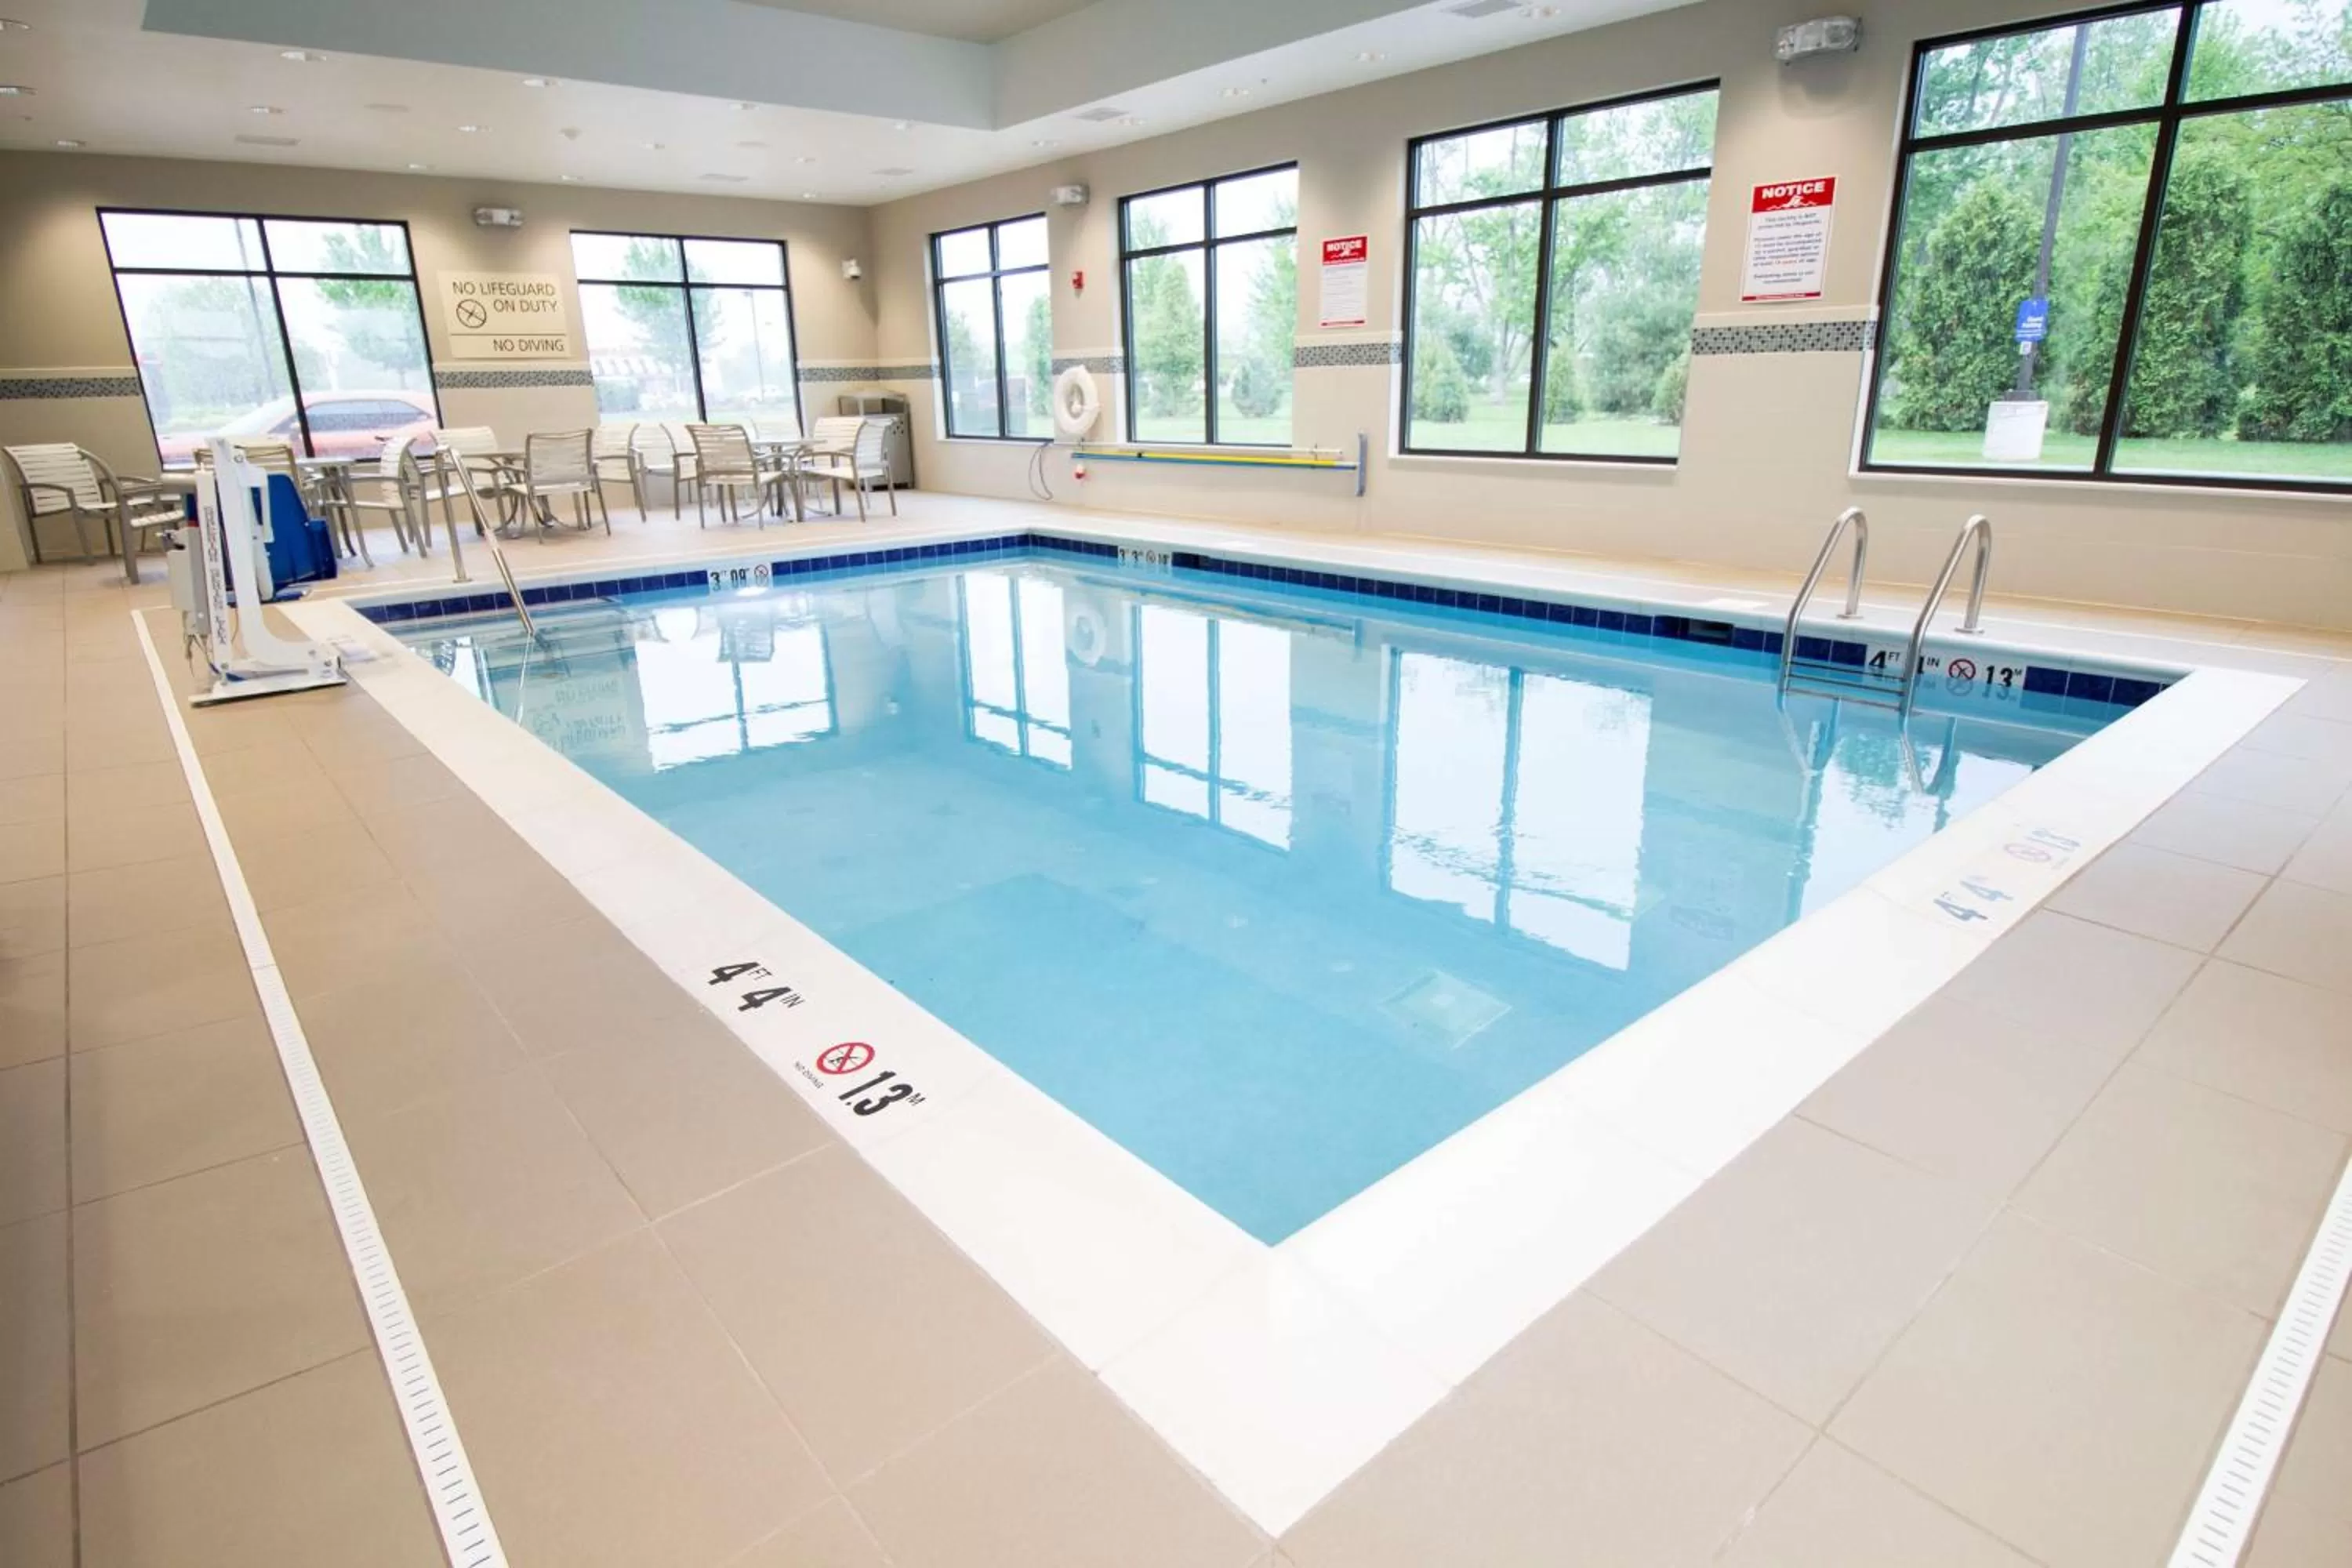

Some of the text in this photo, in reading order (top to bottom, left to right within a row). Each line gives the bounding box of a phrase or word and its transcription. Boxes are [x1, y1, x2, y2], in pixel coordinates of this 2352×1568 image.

[1762, 181, 1826, 199] NOTICE
[452, 281, 556, 296] NO LIFEGUARD
[493, 299, 557, 312] ON DUTY
[493, 339, 565, 352] NO DIVING
[1869, 651, 1886, 670] 4
[1889, 652, 1900, 662] FT
[1926, 657, 1940, 667] IN
[1933, 898, 1989, 921] 4
[708, 961, 773, 985] 4 FT
[738, 986, 805, 1012] 4 IN
[838, 1071, 913, 1116] 1.3
